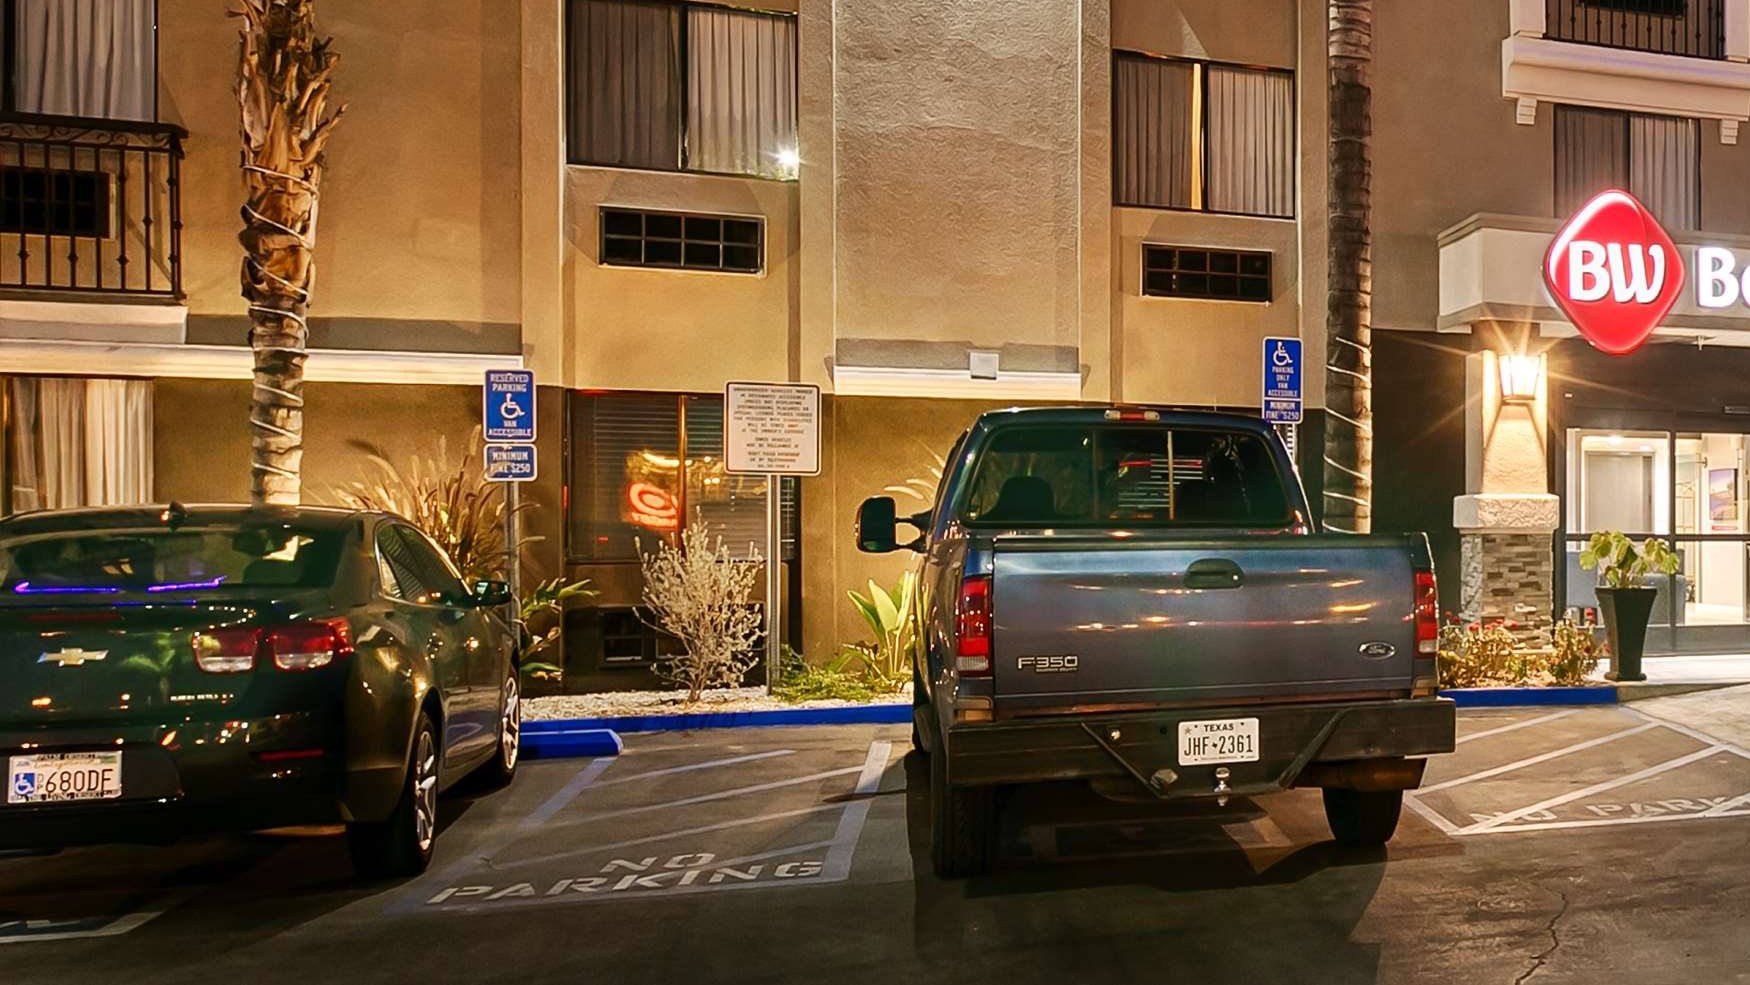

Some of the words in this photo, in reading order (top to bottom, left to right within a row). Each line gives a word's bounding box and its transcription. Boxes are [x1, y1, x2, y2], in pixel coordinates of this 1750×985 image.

[1567, 240, 1666, 305] BW
[493, 384, 527, 392] PARKING
[1203, 723, 1235, 733] TEXAS
[600, 852, 717, 874] NO
[425, 860, 824, 905] PARKING
